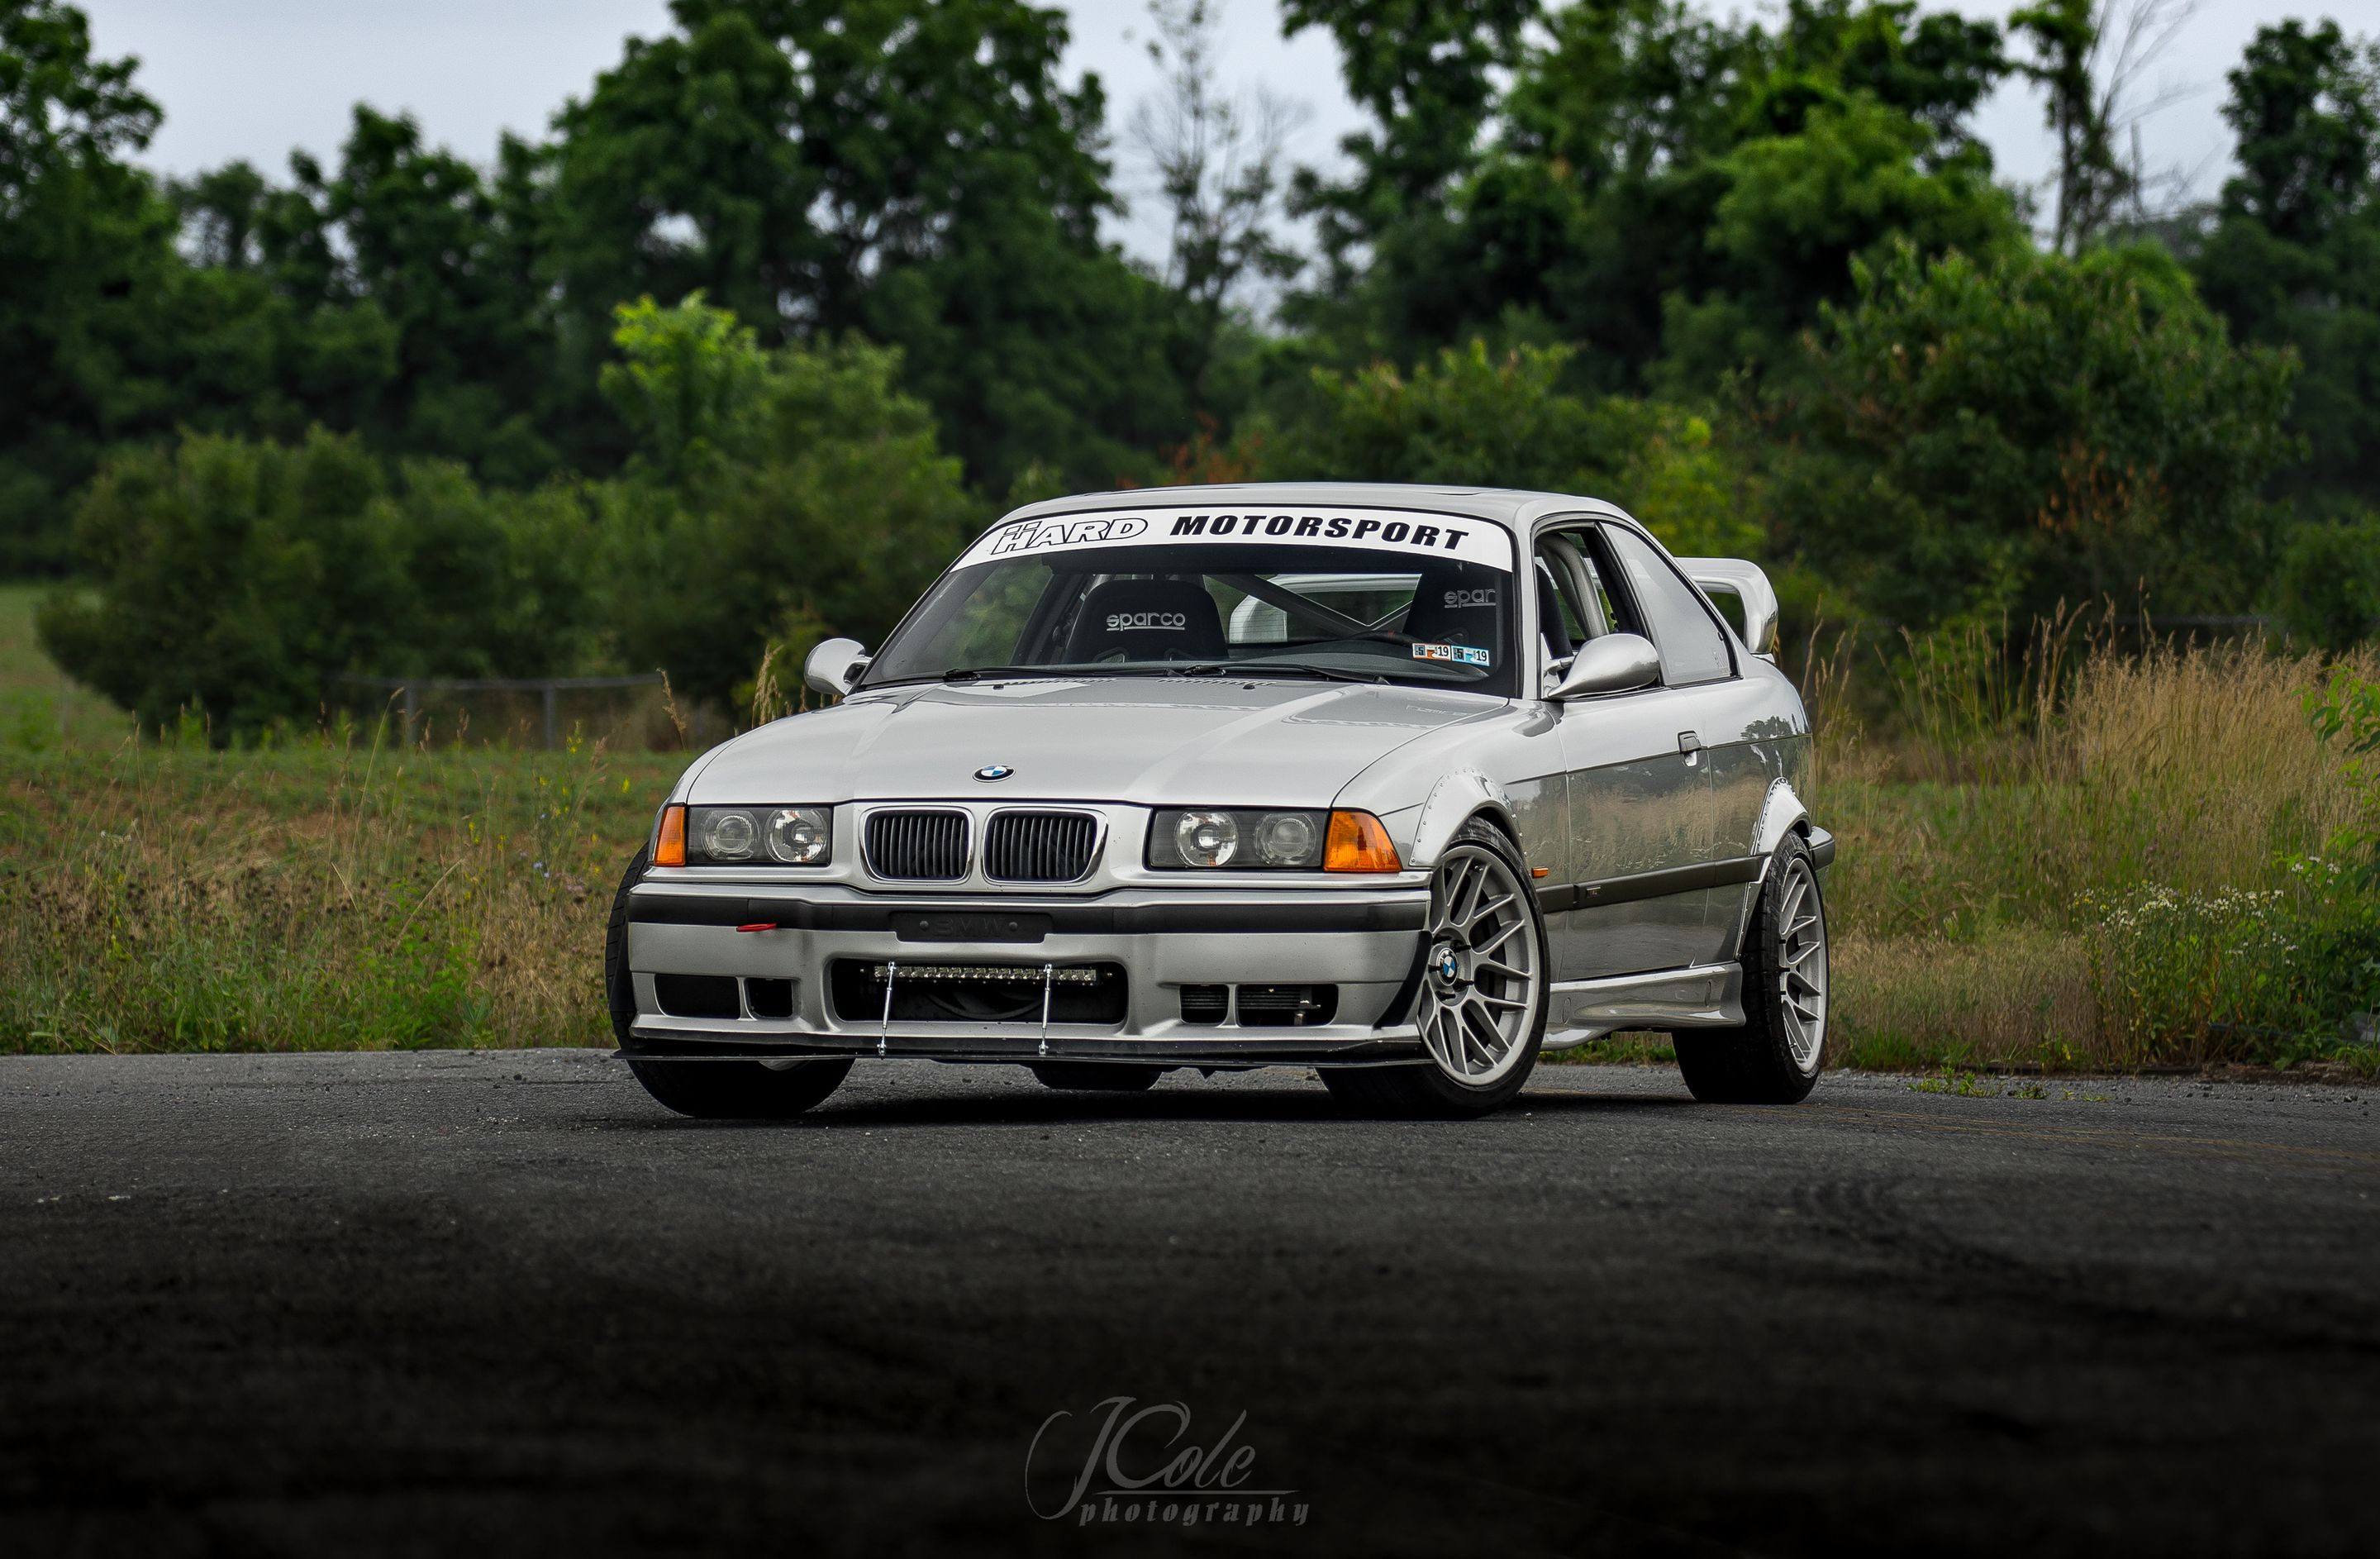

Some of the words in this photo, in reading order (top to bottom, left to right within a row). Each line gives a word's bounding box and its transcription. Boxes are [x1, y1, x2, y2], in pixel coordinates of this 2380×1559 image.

[990, 517, 1149, 555] HARD
[1169, 515, 1469, 550] MOTORSPORT
[1444, 589, 1496, 608] spar
[1106, 613, 1186, 631] sparco
[1418, 646, 1424, 656] 5
[1438, 646, 1449, 656] 19
[1457, 648, 1464, 659] 5
[1476, 650, 1487, 661] 19
[931, 918, 1005, 937] BMW
